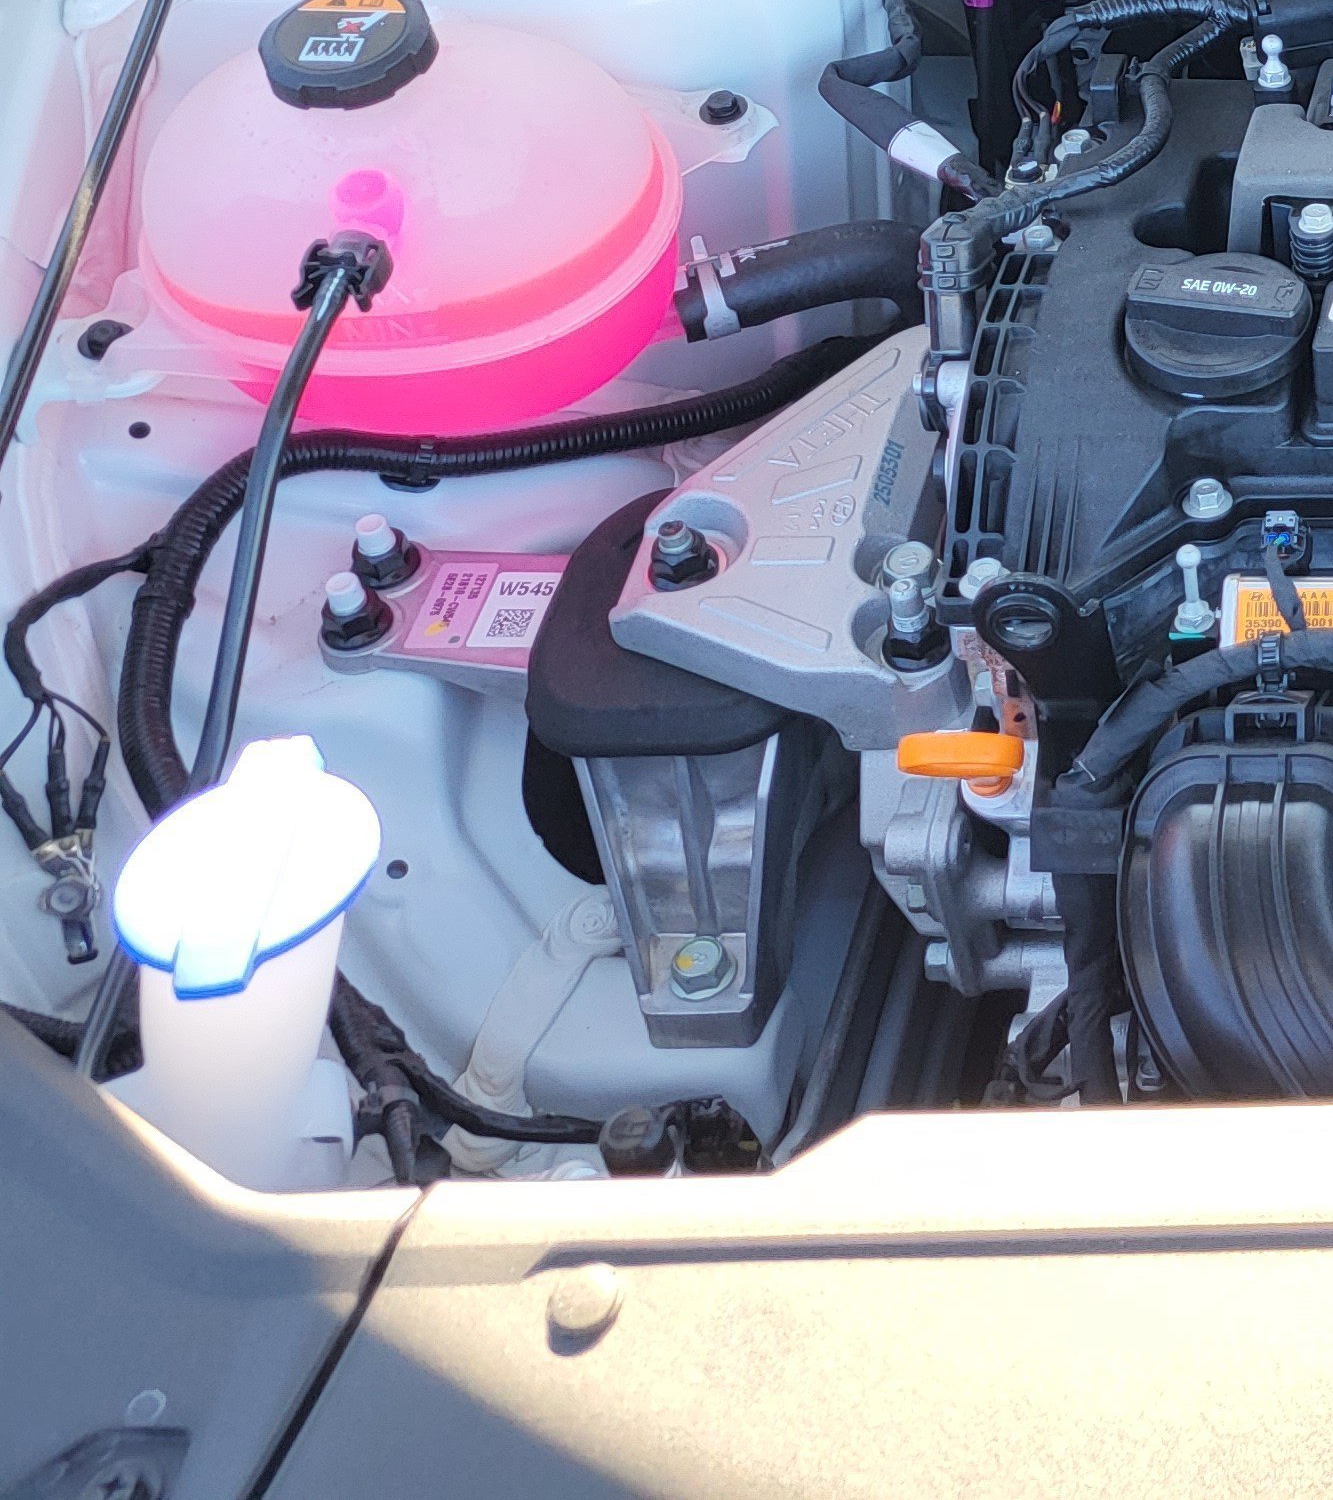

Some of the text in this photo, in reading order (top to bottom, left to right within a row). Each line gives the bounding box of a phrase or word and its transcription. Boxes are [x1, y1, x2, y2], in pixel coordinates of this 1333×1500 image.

[1181, 278, 1258, 297] SAE 0W-20
[499, 580, 555, 599] W545
